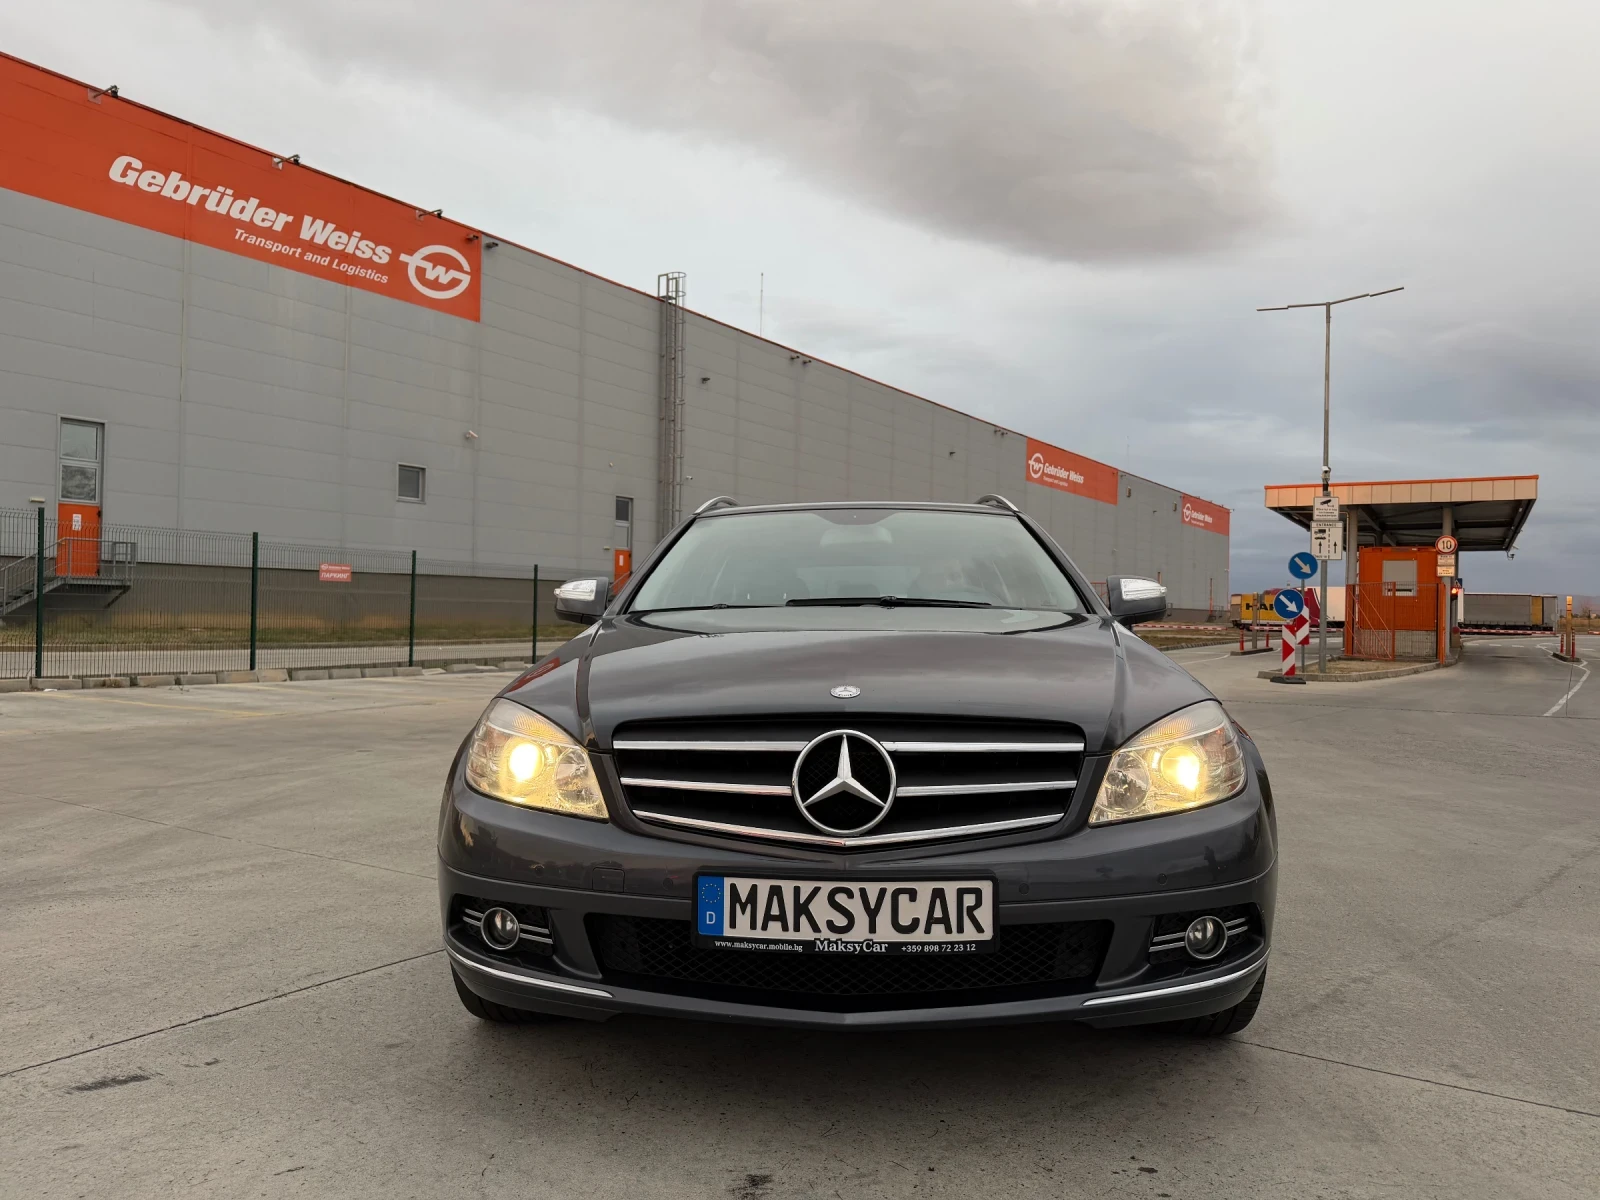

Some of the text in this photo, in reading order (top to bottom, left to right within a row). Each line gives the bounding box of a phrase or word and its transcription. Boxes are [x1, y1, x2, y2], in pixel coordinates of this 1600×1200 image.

[109, 155, 392, 264] Gebrüder Weiss
[234, 228, 389, 284] Transport and Logistics
[1441, 540, 1452, 550] 10
[706, 882, 985, 935] D MAKSYCAR
[714, 940, 803, 952] www.maksycar.mobile.bg
[814, 940, 888, 954] MaksyCar
[901, 945, 922, 953] +359
[923, 944, 939, 952] 898
[941, 944, 952, 952] 72
[966, 943, 976, 951] 12
